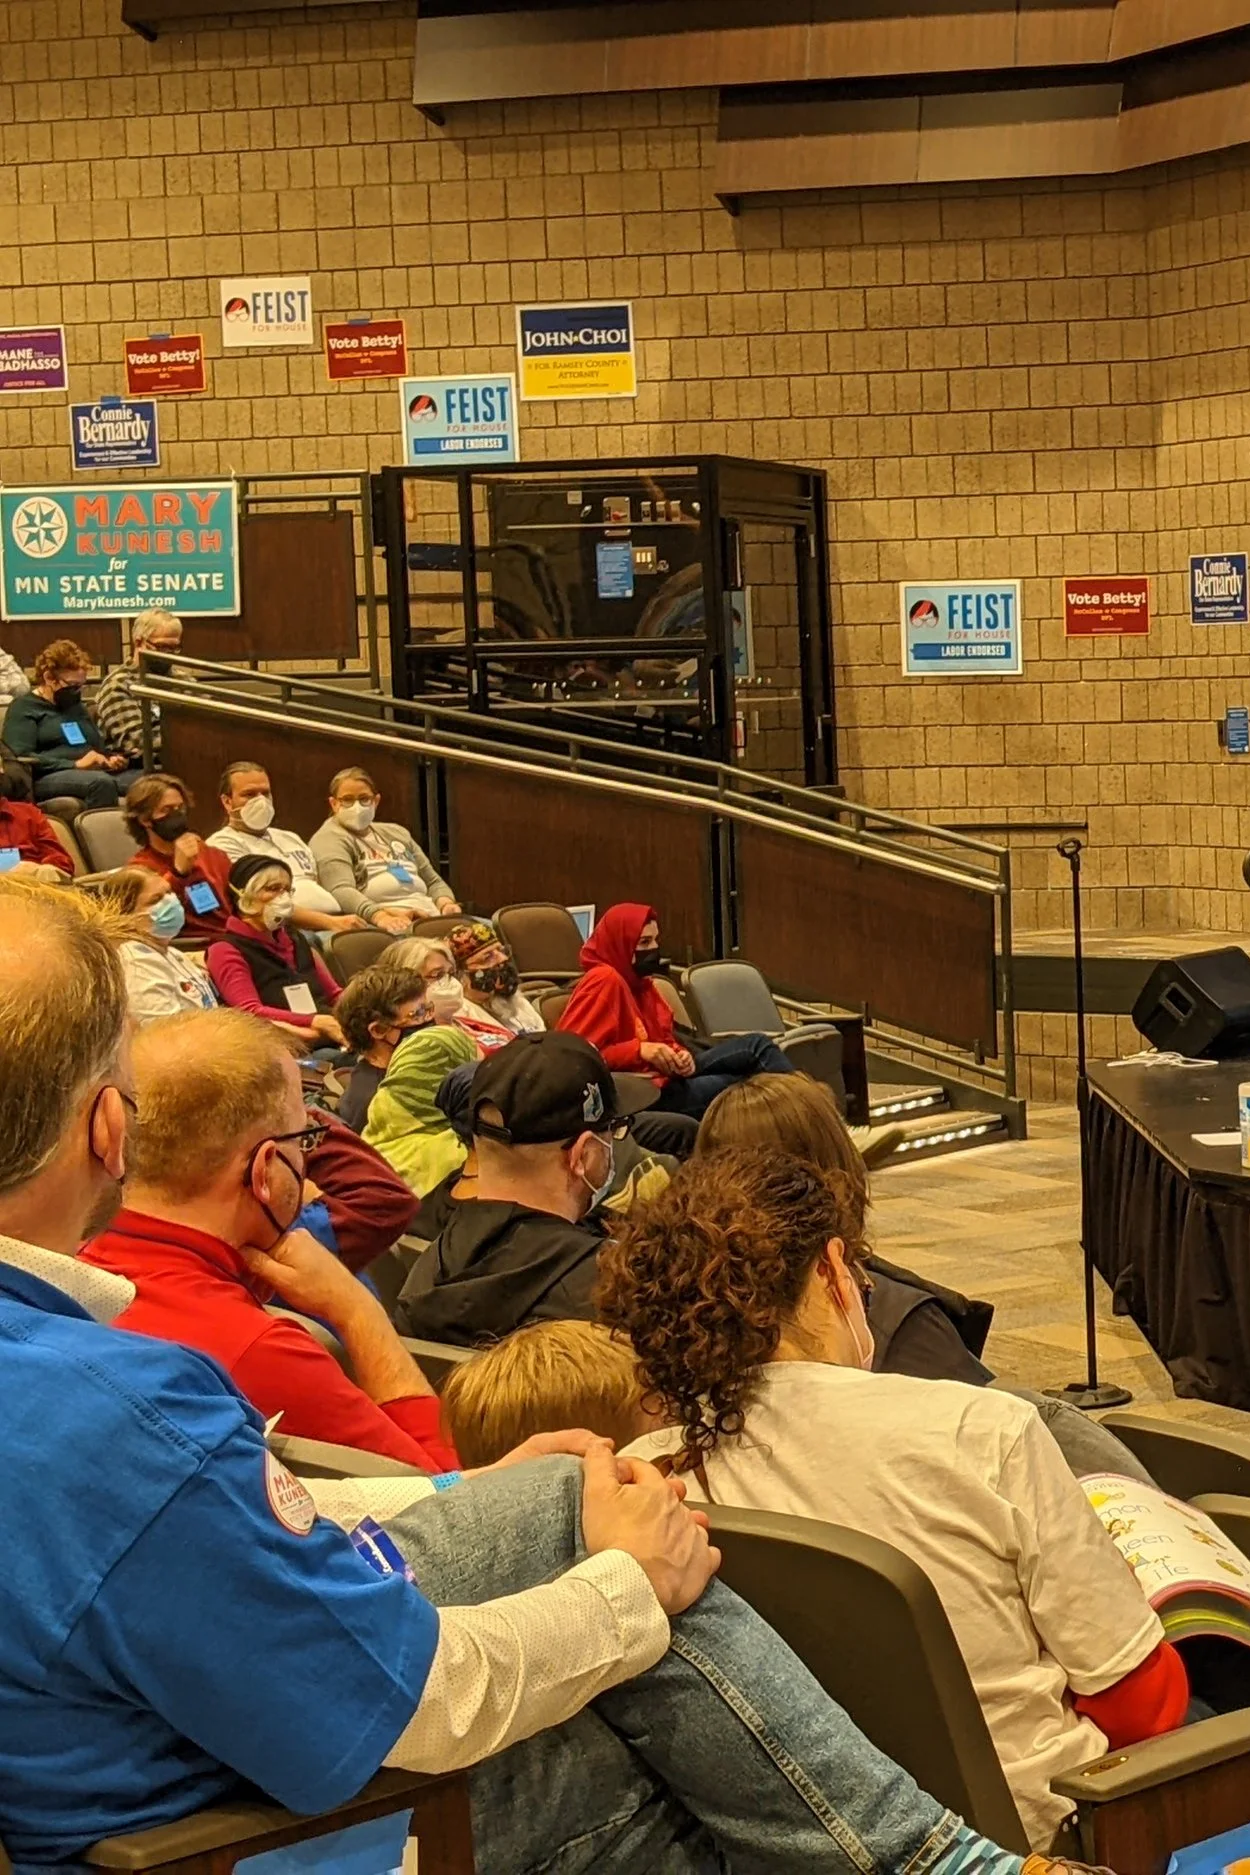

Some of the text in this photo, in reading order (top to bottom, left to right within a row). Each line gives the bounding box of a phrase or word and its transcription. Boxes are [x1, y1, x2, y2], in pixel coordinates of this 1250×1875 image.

[252, 291, 308, 323] FEIST
[328, 333, 403, 350] Vote Betty!
[524, 328, 628, 352] JOHN CHOI
[128, 348, 200, 365] Vote Betty!
[585, 360, 620, 368] COUNTY
[558, 370, 600, 379] ATTORNEY
[91, 404, 133, 422] Connie
[445, 387, 508, 423] FEIST
[77, 413, 152, 447] Bernardy
[74, 492, 220, 527] MARY
[76, 529, 222, 555] KUNESH
[108, 557, 128, 572] for
[1203, 557, 1231, 575] Connie
[15, 573, 224, 594] MN STATE SENATE
[1194, 567, 1243, 603] Bernardy
[63, 595, 176, 610] MaryKunesh.com
[1068, 592, 1146, 607] Vote Betty!
[947, 593, 1013, 629] FEIST
[975, 631, 1010, 639] HOUSE
[941, 644, 1006, 657] LABOR ENDORSED
